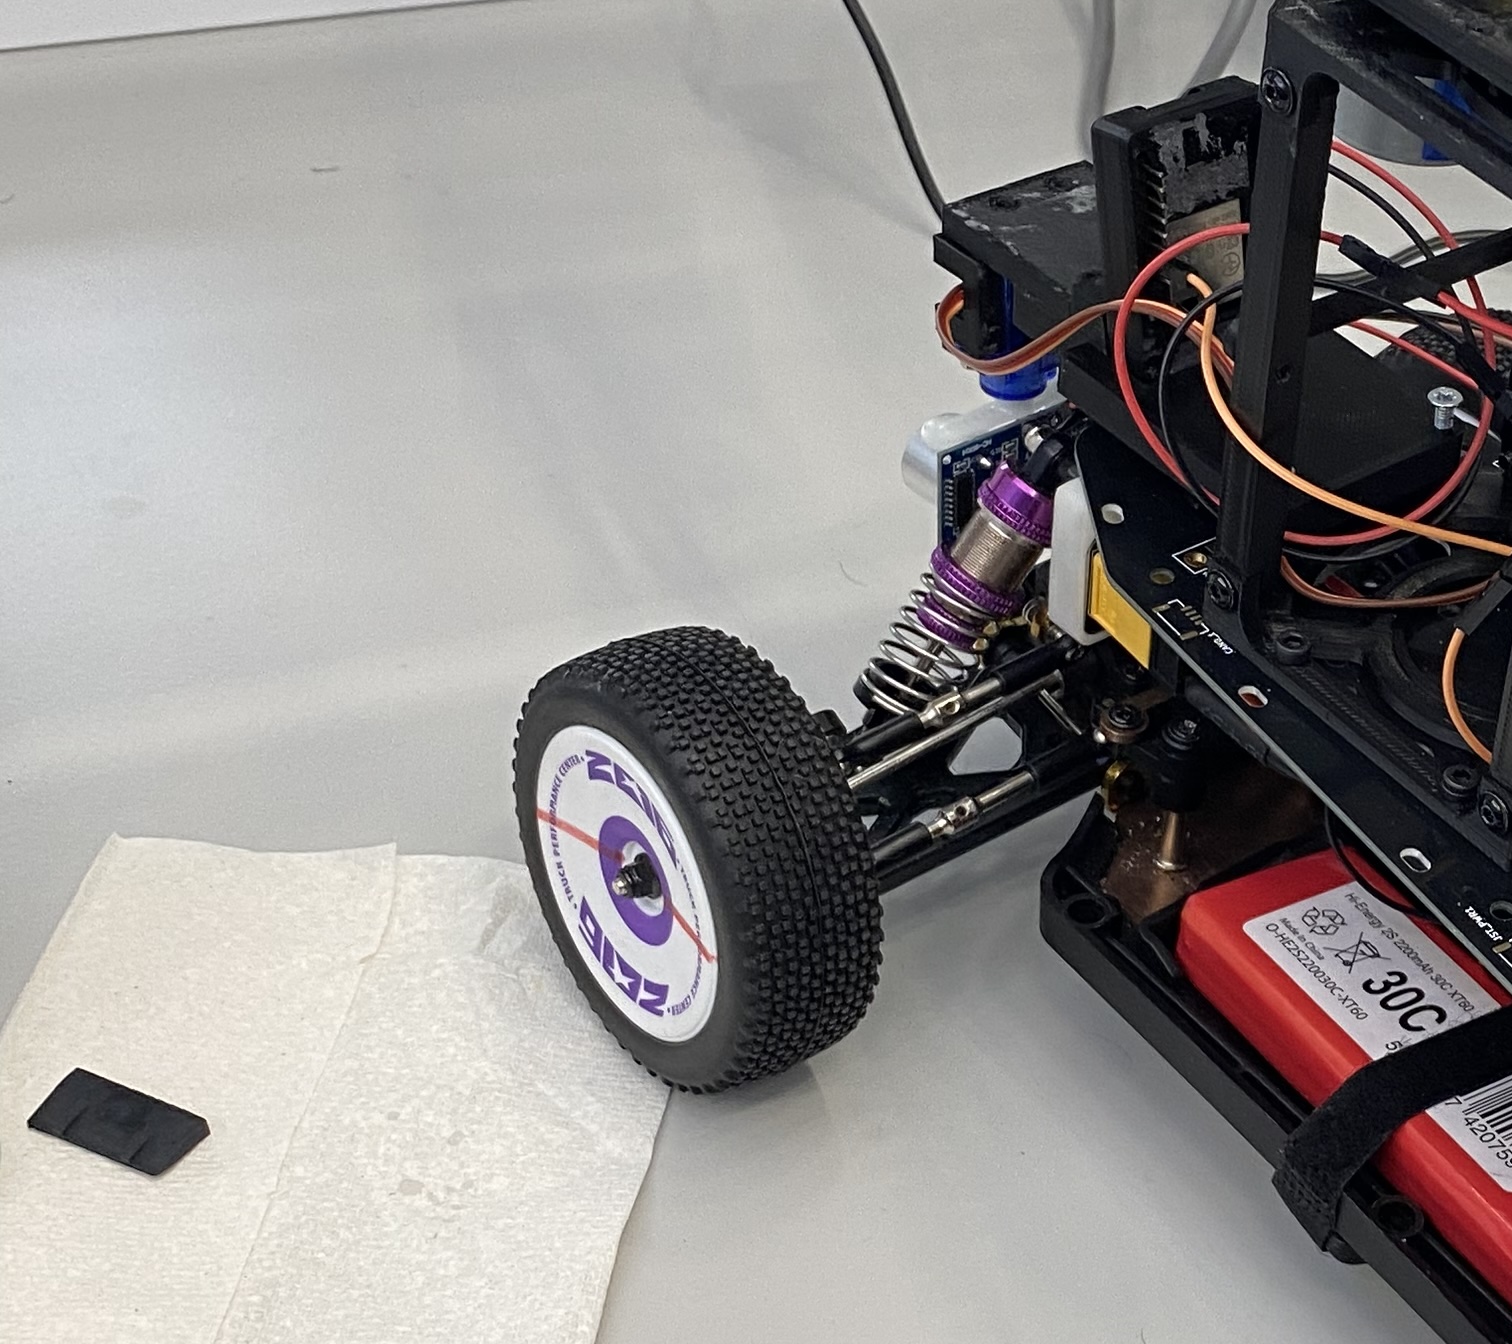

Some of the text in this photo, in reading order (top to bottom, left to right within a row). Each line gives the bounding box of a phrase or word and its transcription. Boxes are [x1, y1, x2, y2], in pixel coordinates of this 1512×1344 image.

[1279, 917, 1299, 937] Made
[1304, 940, 1325, 961] China
[1344, 892, 1475, 1012] Hi-Energy 2S 2200mAh 30C XT60
[1361, 970, 1447, 1033] 30C
[1444, 1096, 1463, 1106] 7
